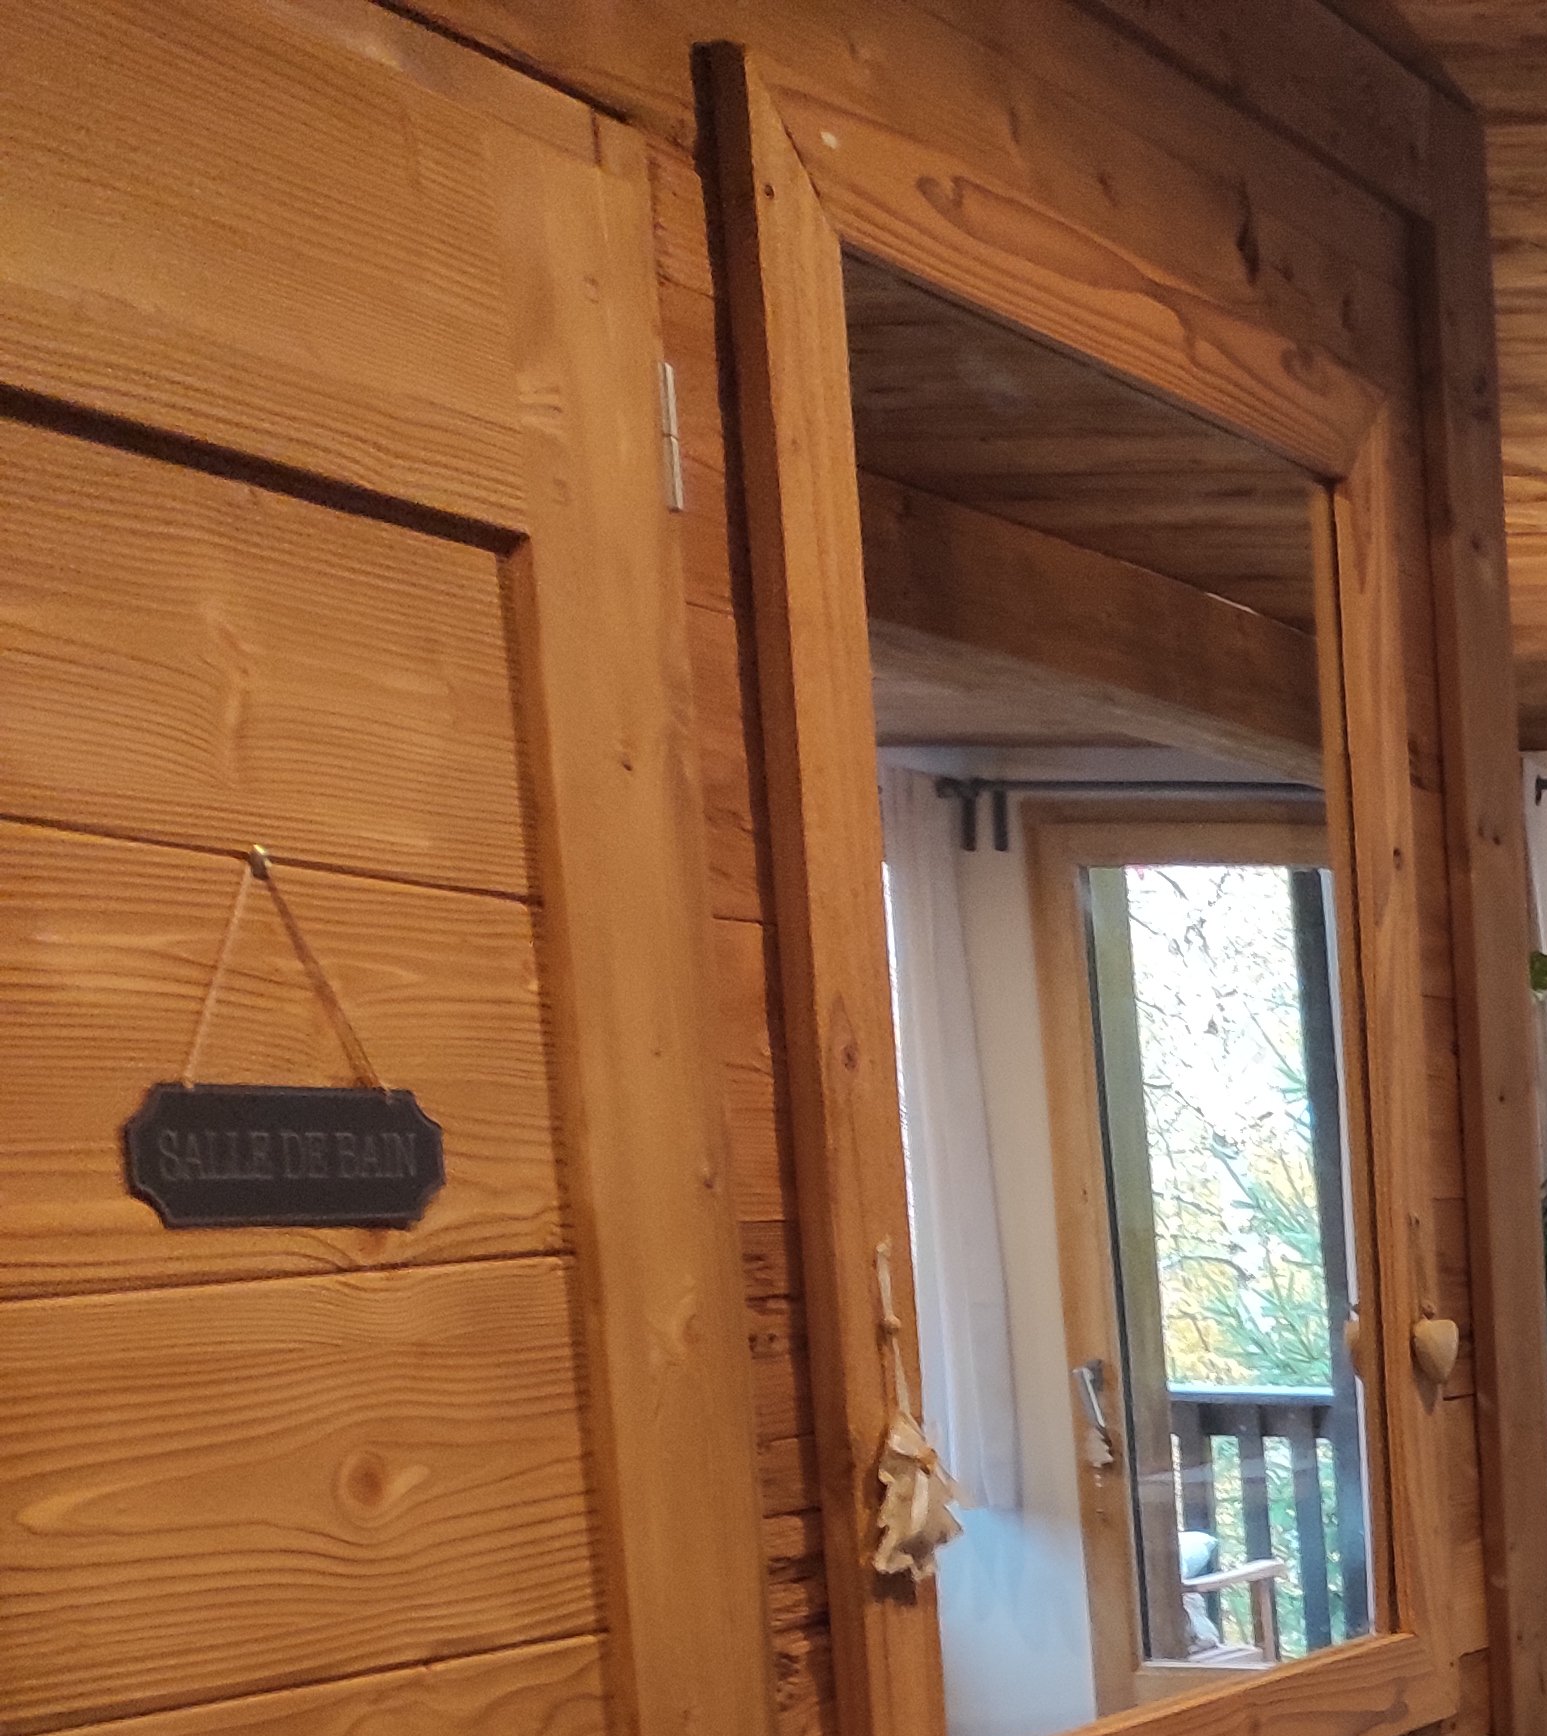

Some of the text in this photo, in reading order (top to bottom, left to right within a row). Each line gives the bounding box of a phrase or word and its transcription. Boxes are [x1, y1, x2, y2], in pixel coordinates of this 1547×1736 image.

[159, 1129, 417, 1180] SALLE DE BAIN
